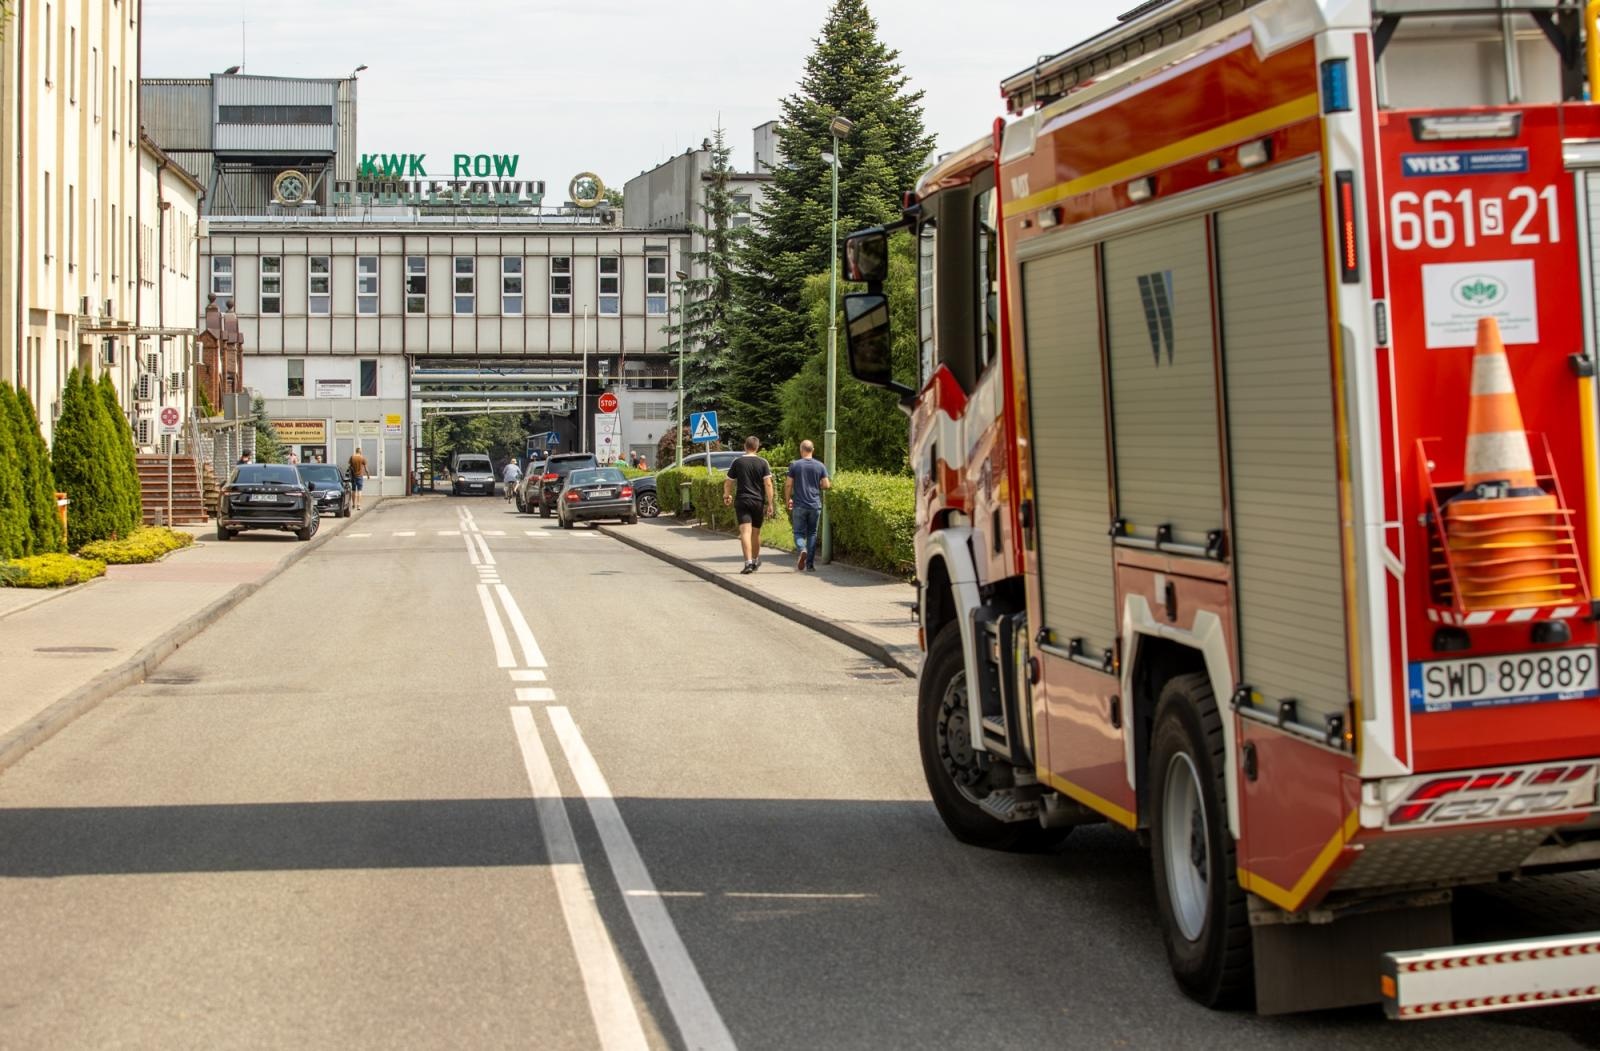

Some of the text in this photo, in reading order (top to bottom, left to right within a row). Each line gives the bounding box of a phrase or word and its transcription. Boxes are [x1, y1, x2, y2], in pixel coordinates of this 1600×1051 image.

[361, 153, 519, 178] KWK ROW
[1390, 188, 1476, 250] 661
[1508, 184, 1560, 245] 21
[1426, 653, 1592, 699] SWD 89889
